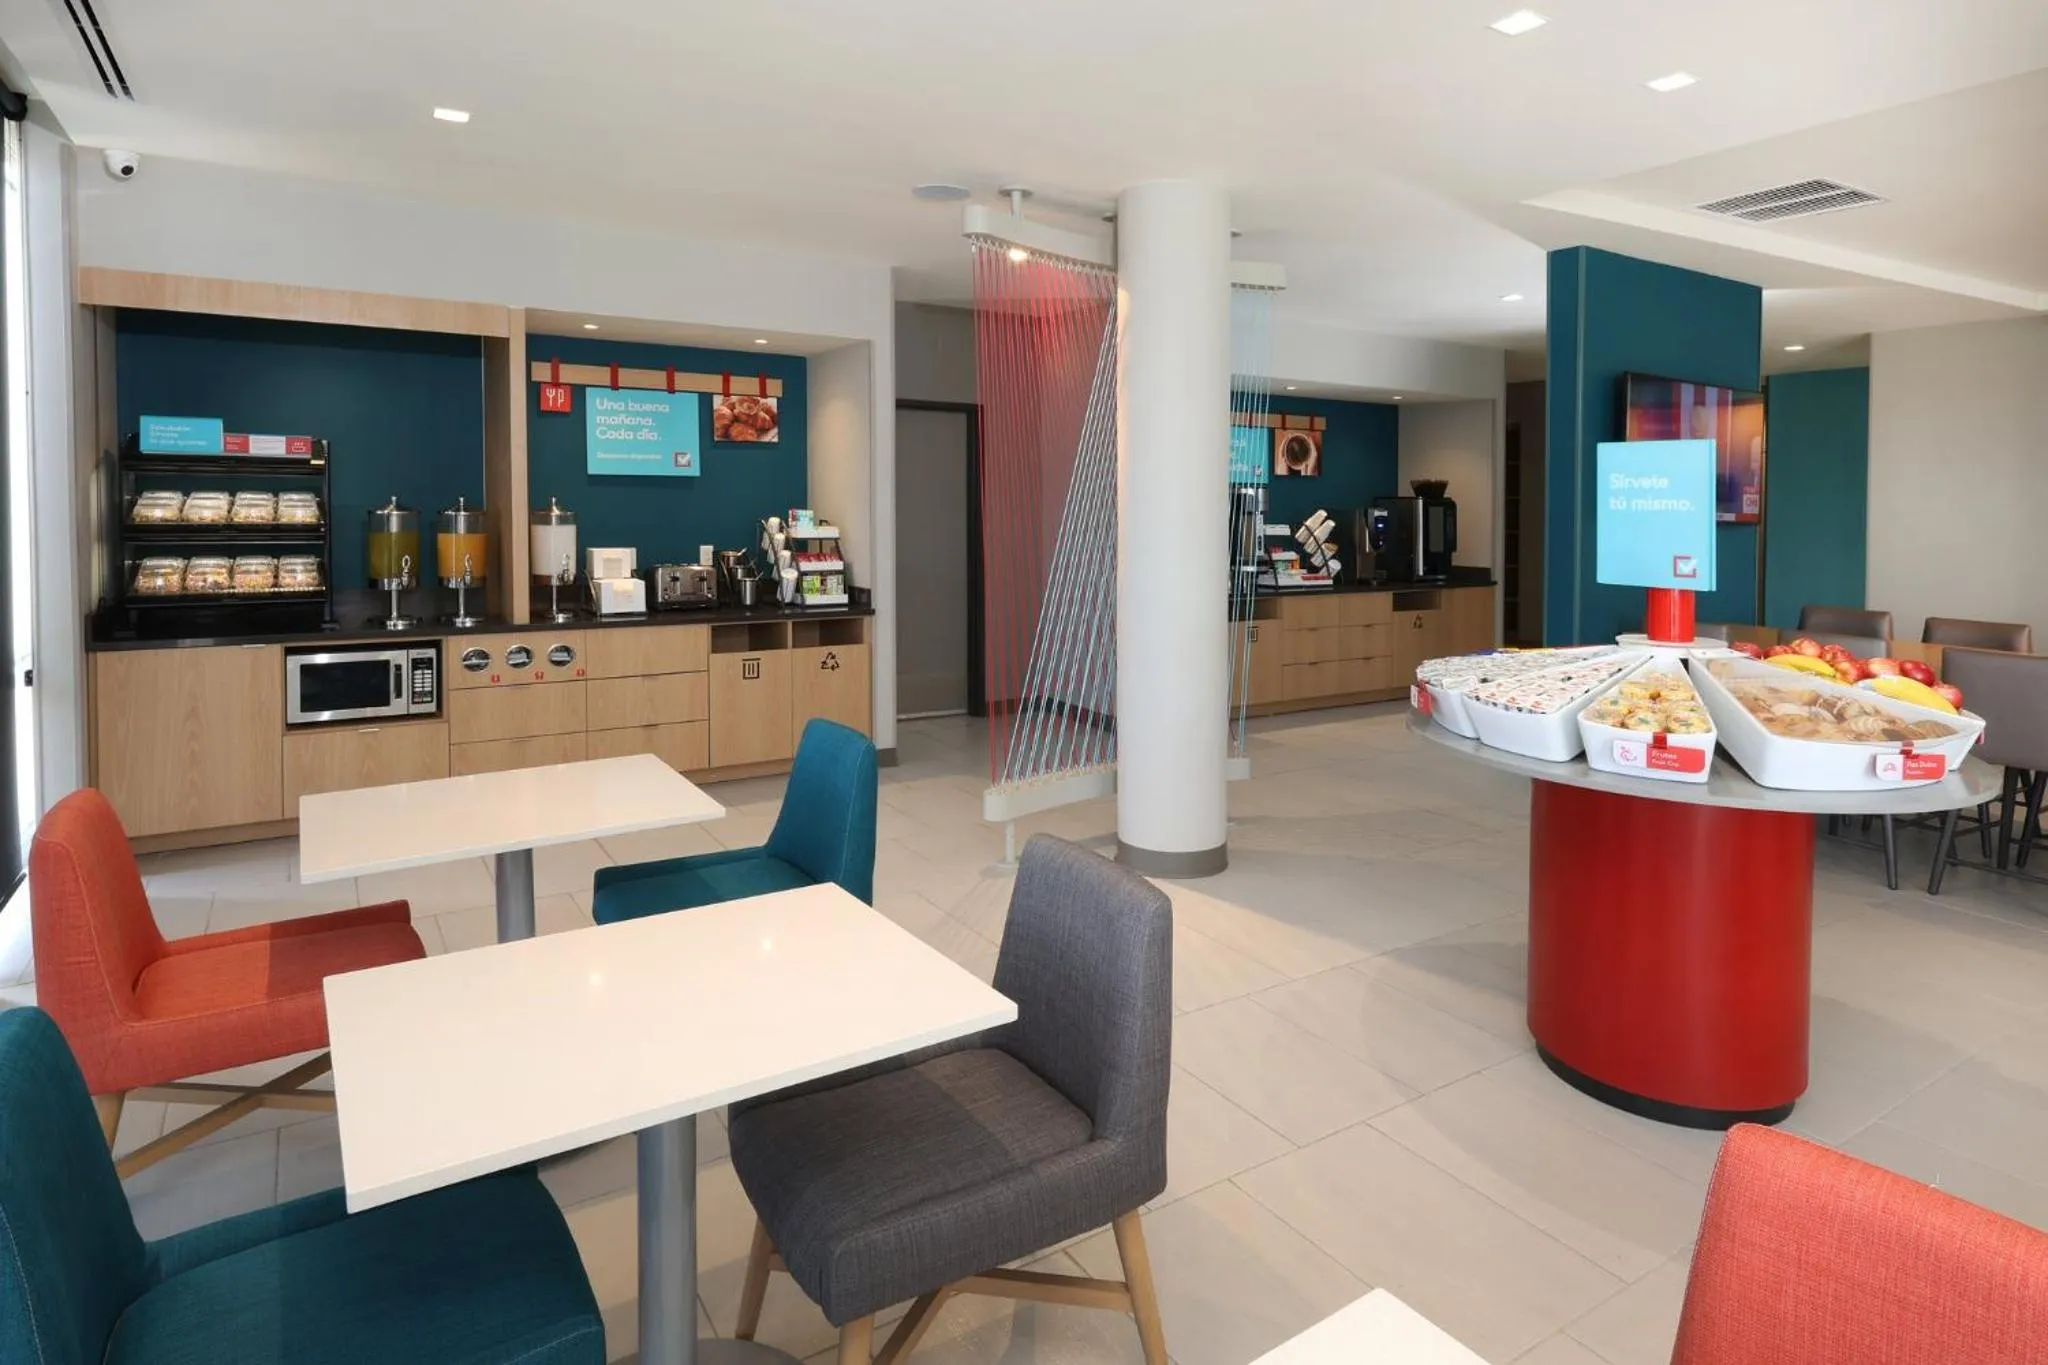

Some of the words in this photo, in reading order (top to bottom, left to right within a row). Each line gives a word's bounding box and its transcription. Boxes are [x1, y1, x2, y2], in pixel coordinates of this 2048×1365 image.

[595, 397, 625, 411] Una
[628, 397, 670, 413] buena
[596, 413, 656, 427] mañana.
[596, 426, 634, 440] Cada
[1609, 495, 1627, 511] tú
[1631, 494, 1695, 513] mismo.
